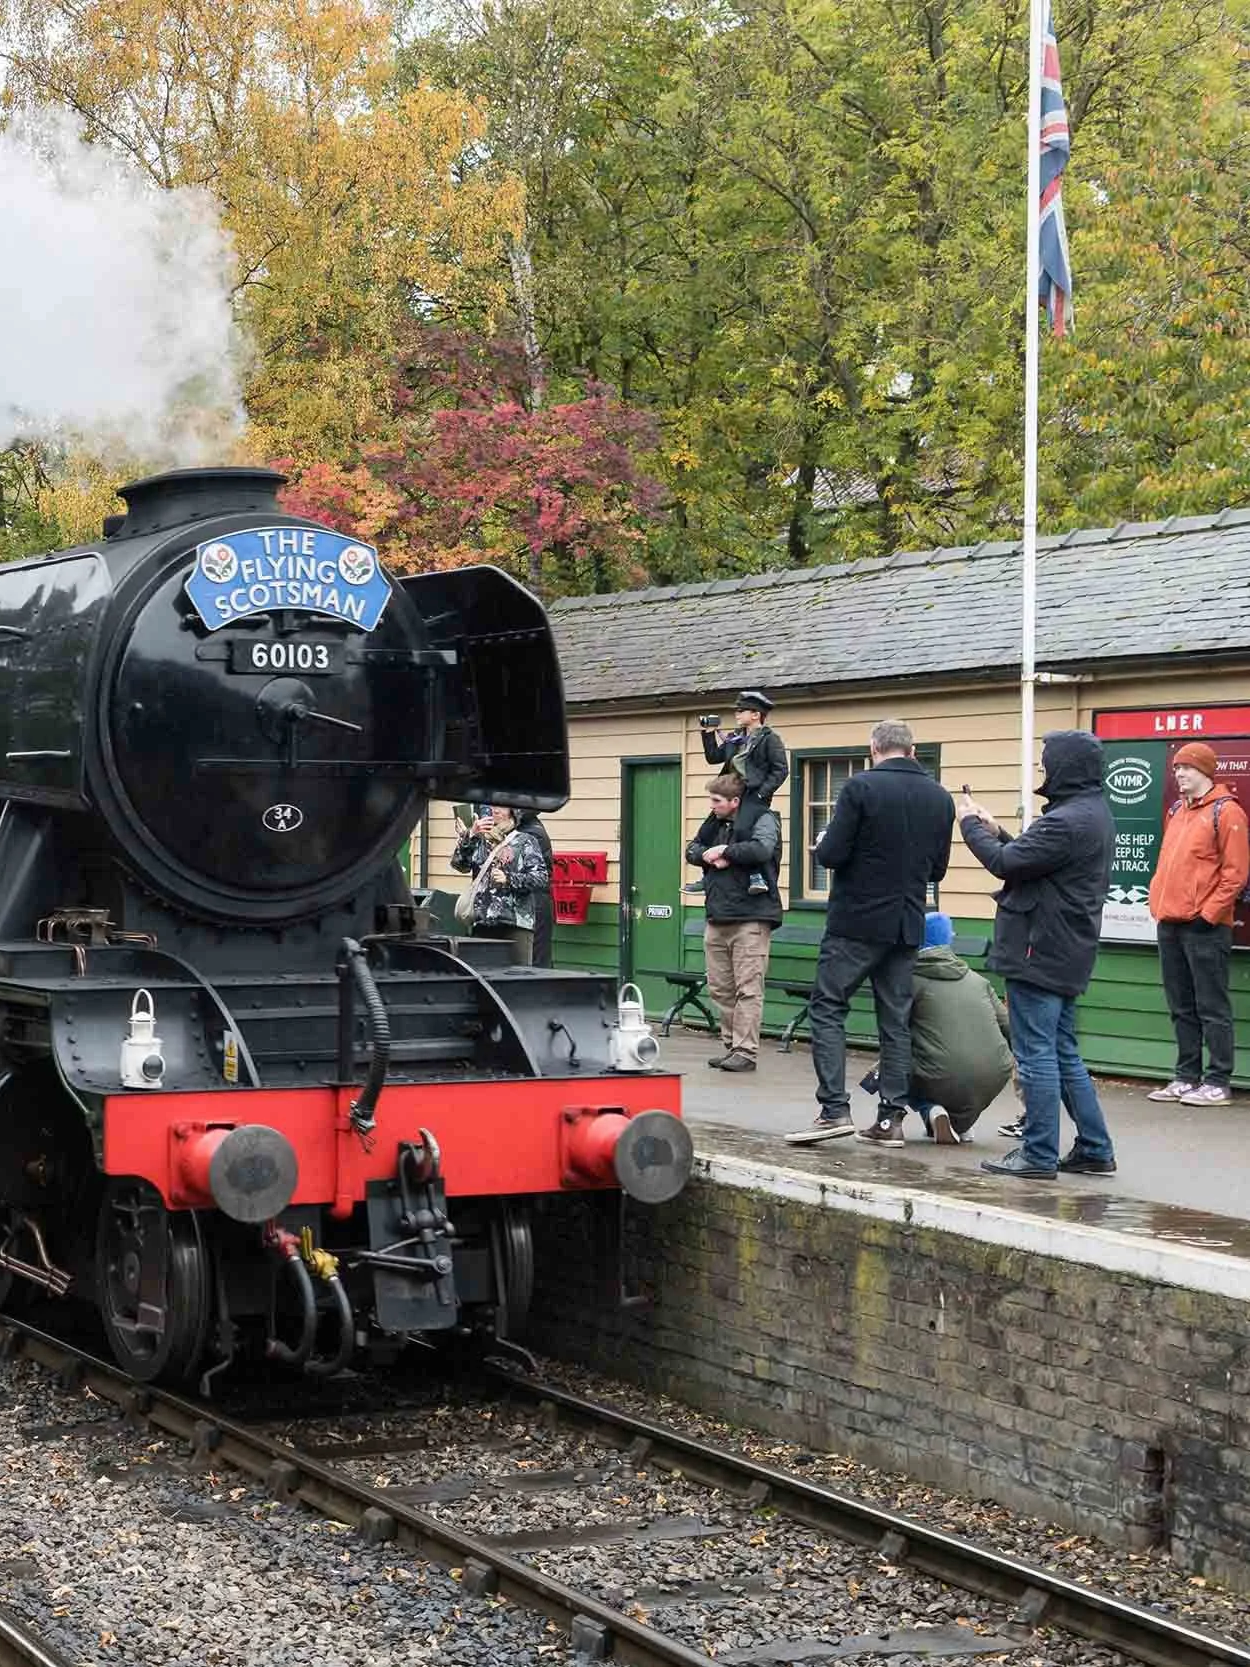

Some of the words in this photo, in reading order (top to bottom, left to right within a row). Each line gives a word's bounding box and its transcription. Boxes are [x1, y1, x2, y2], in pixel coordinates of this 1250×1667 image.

[257, 530, 317, 555] THE
[240, 556, 337, 584] FLYING
[215, 581, 366, 621] SCOTSMAN
[252, 643, 329, 669] 60103
[1155, 714, 1203, 731] LNER
[1114, 775, 1143, 787] NYMR
[274, 807, 293, 820] 34
[277, 819, 287, 830] A
[1114, 833, 1131, 845] ASE
[1132, 834, 1154, 846] HELP
[1115, 847, 1131, 858] EEP
[1132, 847, 1145, 859] US
[1111, 861, 1120, 871] N
[1121, 860, 1150, 872] TRACK
